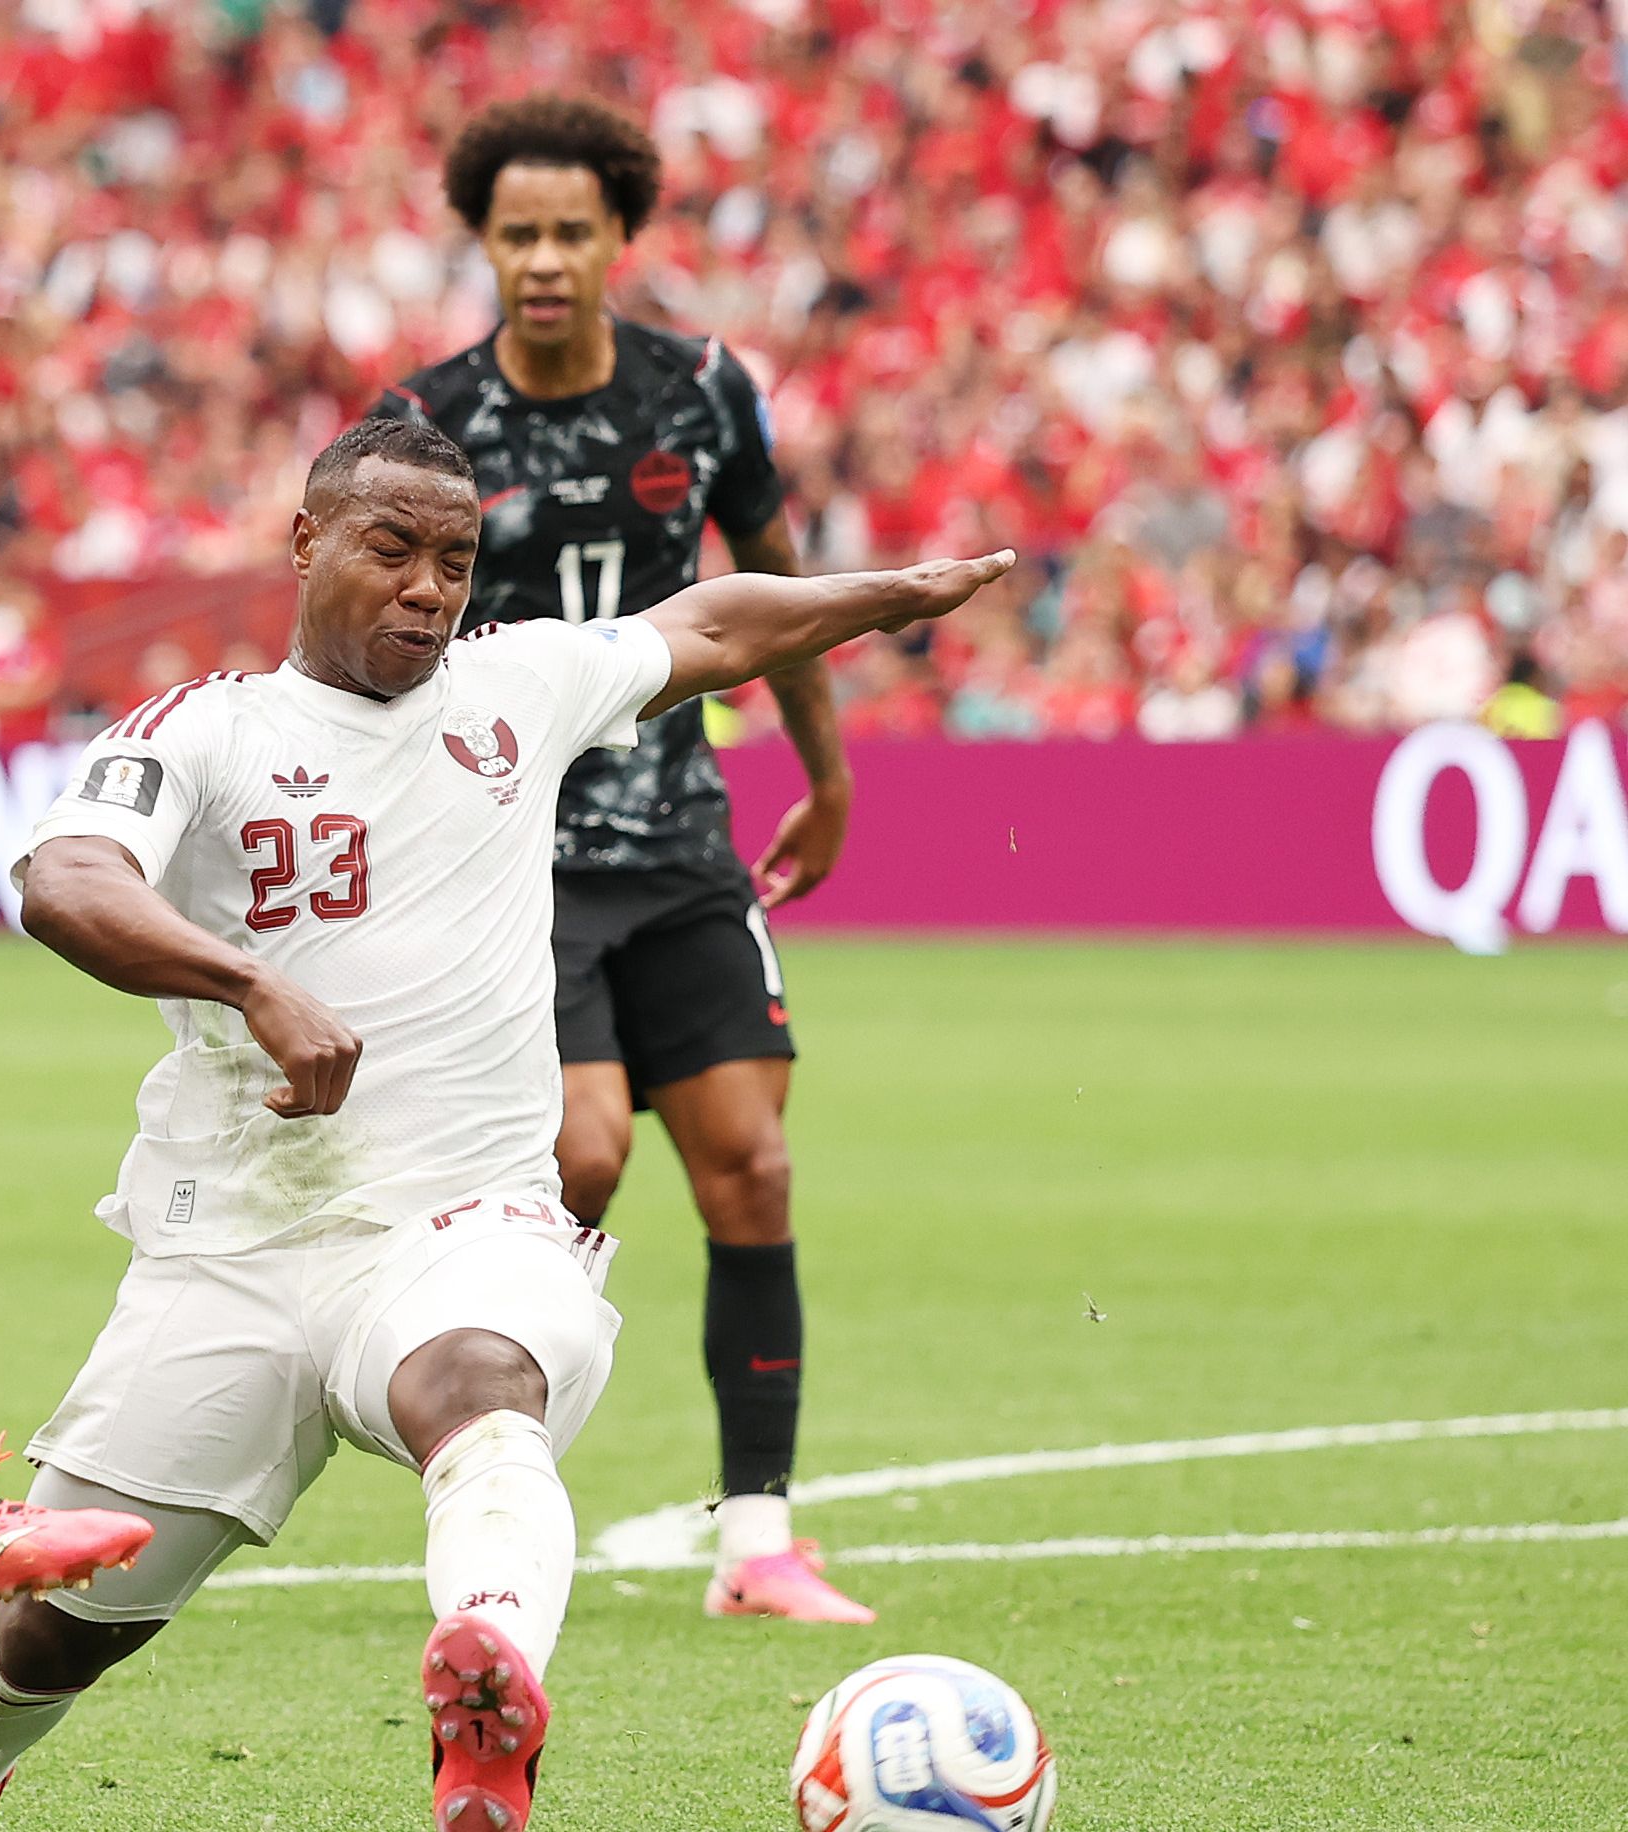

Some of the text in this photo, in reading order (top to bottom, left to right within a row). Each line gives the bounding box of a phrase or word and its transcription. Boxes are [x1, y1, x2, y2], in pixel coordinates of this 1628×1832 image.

[555, 539, 625, 625] 17
[477, 755, 513, 776] QFA
[240, 813, 371, 933] 23
[457, 1590, 521, 1611] QFA
